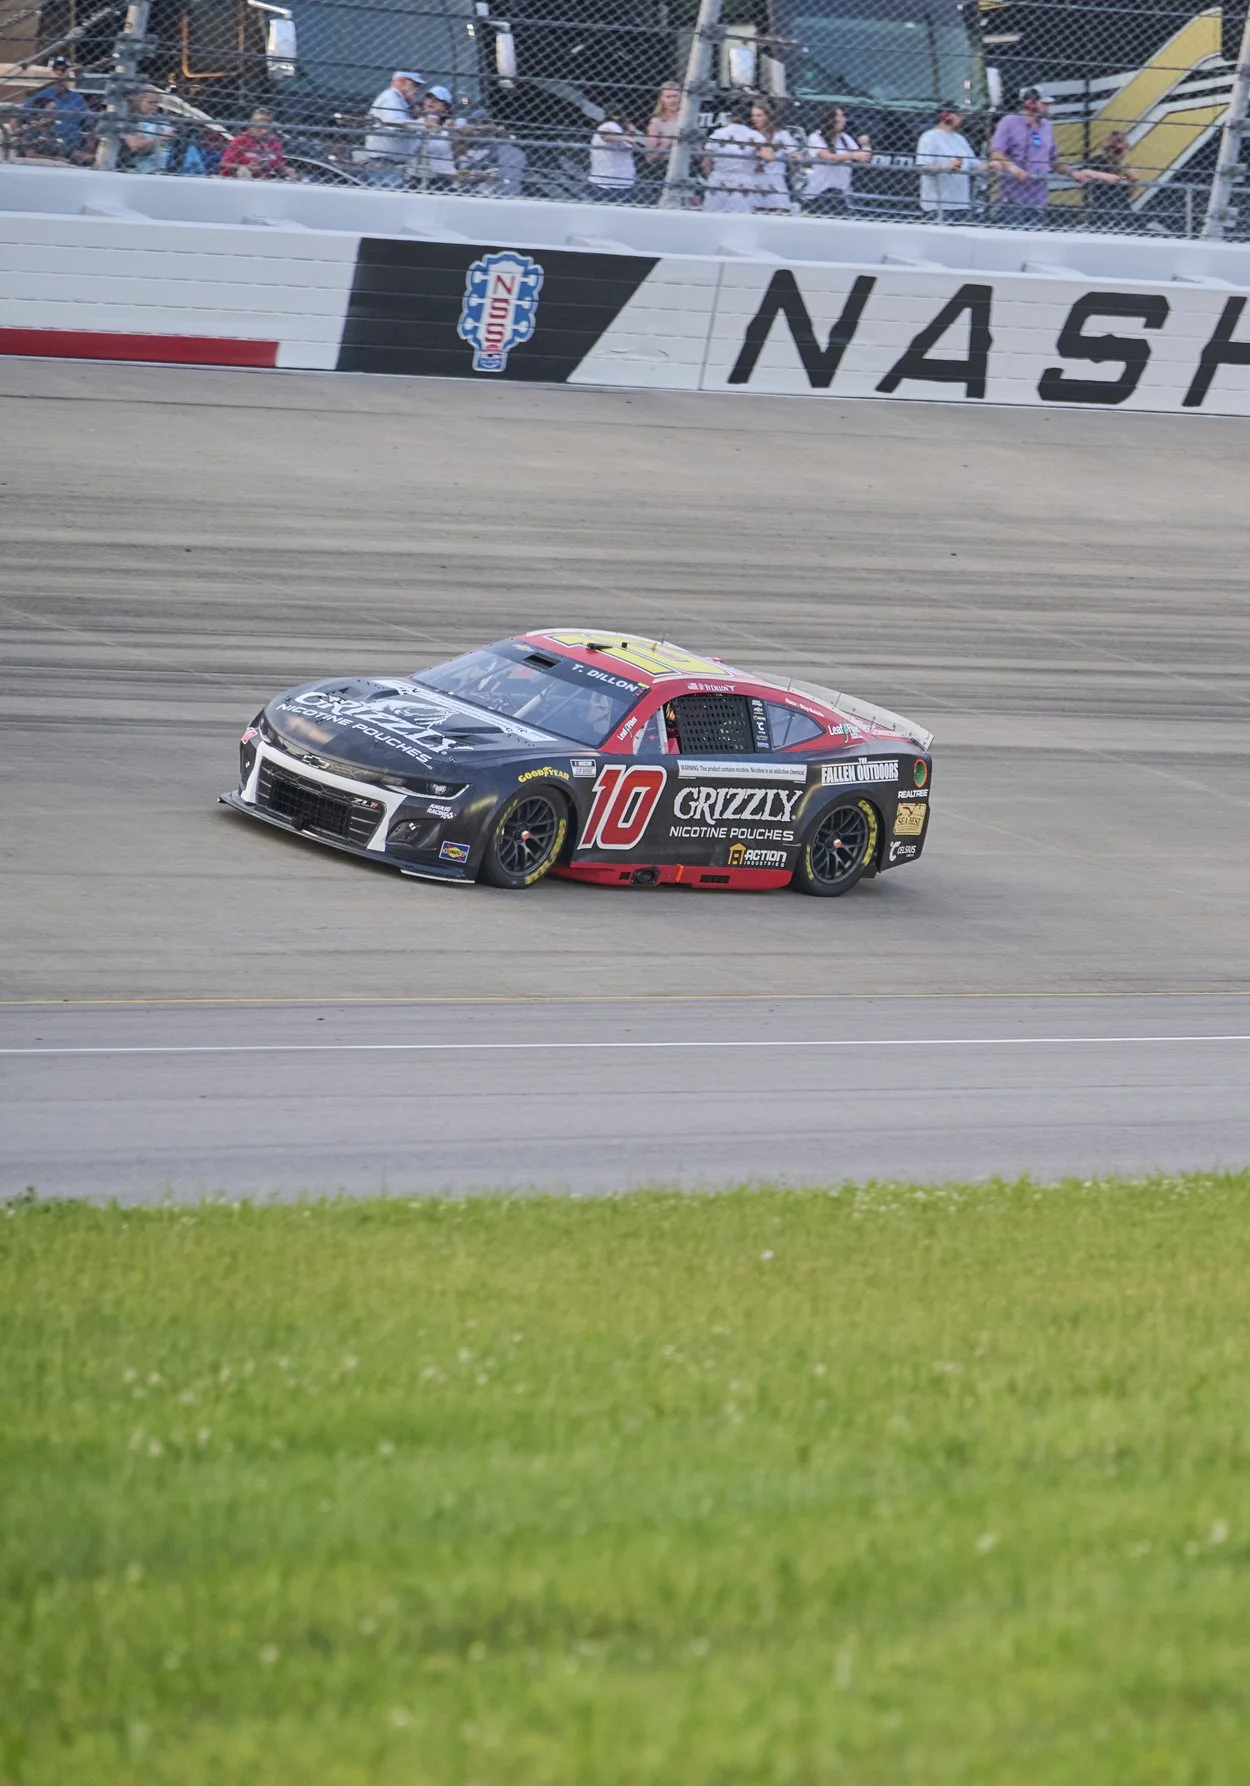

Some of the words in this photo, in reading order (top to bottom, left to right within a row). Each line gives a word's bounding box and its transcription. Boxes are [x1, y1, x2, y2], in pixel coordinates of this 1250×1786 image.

[484, 274, 516, 344] NSS
[572, 664, 583, 673] T.
[586, 668, 639, 693] DILLON
[276, 703, 354, 726] NICOTINE
[352, 722, 432, 763] POUCHES
[518, 766, 570, 783] GOODYEAR
[822, 765, 857, 784] FALLEN
[857, 763, 899, 781] OUTDOORS
[898, 789, 929, 799] REALTREE
[577, 764, 668, 850] 10
[673, 786, 803, 825] GRIZZLY
[669, 826, 728, 839] NICOTINE
[729, 828, 794, 841] POUCHES
[744, 849, 787, 862] ACTION
[897, 845, 917, 855] CELSIUS
